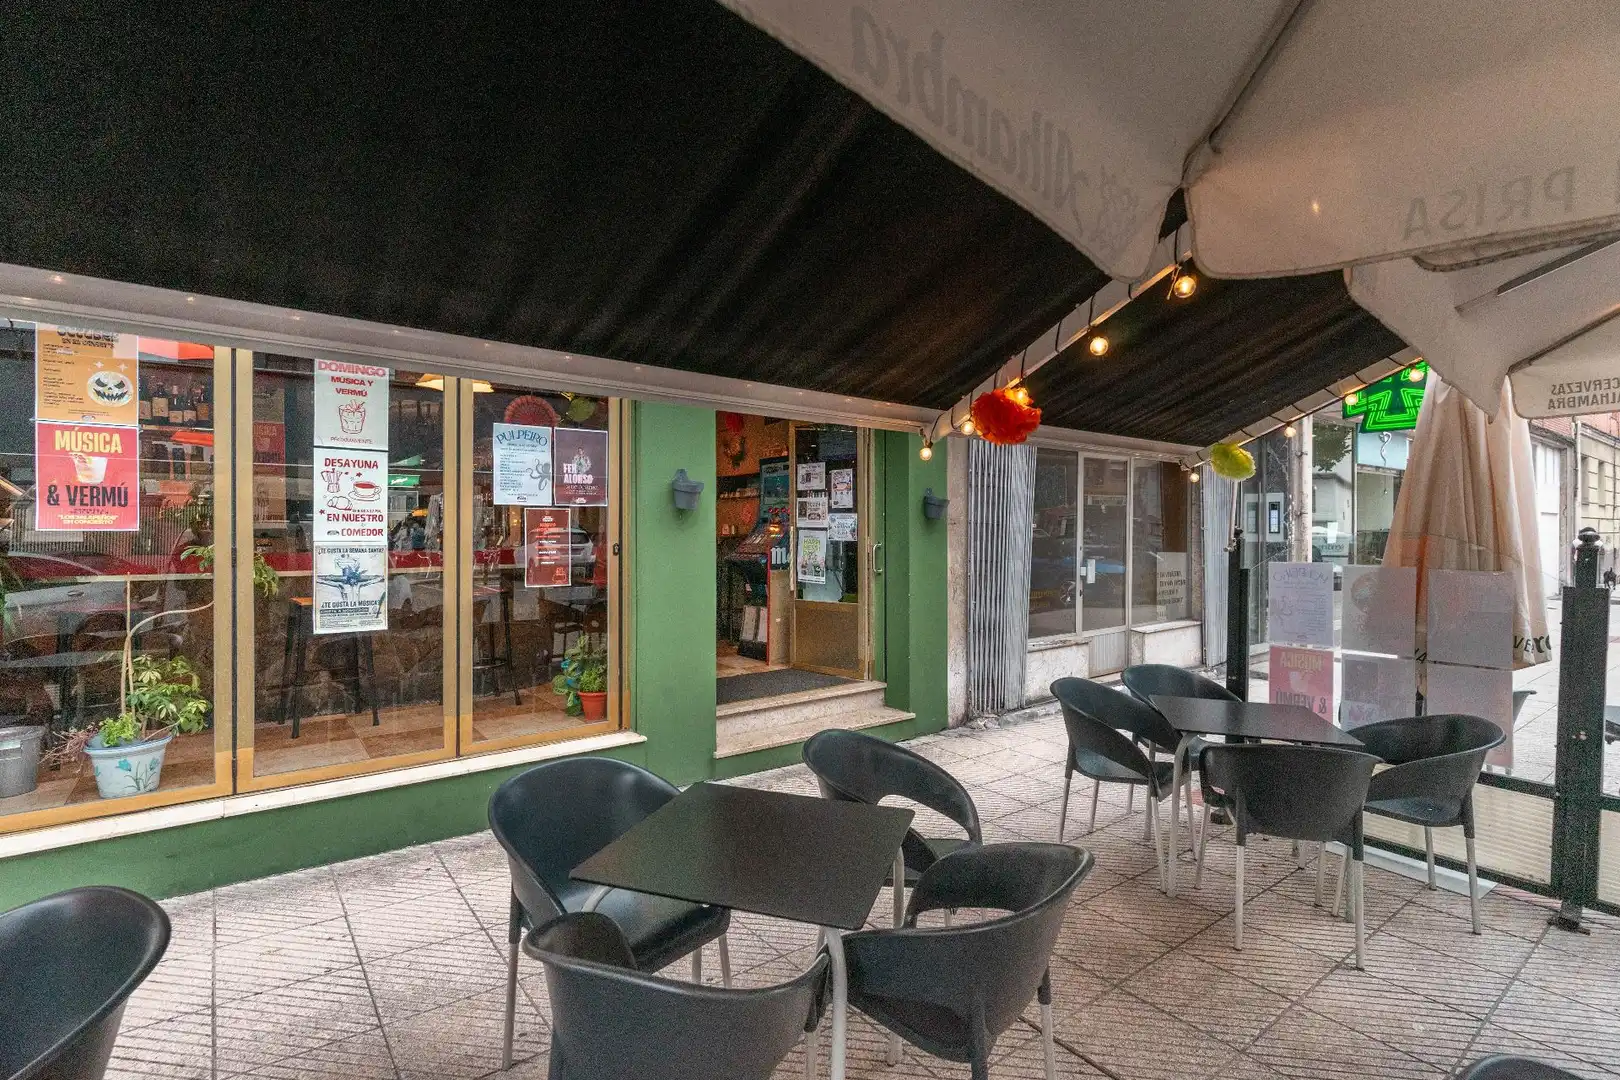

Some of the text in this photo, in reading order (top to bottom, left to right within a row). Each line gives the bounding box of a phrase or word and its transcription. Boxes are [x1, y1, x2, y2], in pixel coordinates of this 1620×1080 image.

[318, 360, 386, 377] DOMINGO
[55, 427, 123, 453] MÚSICA
[324, 458, 379, 469] DESAYUNA
[47, 482, 129, 507] & VERMÚ
[327, 513, 384, 522] EN NUESTRO
[341, 528, 384, 537] COMEDOR
